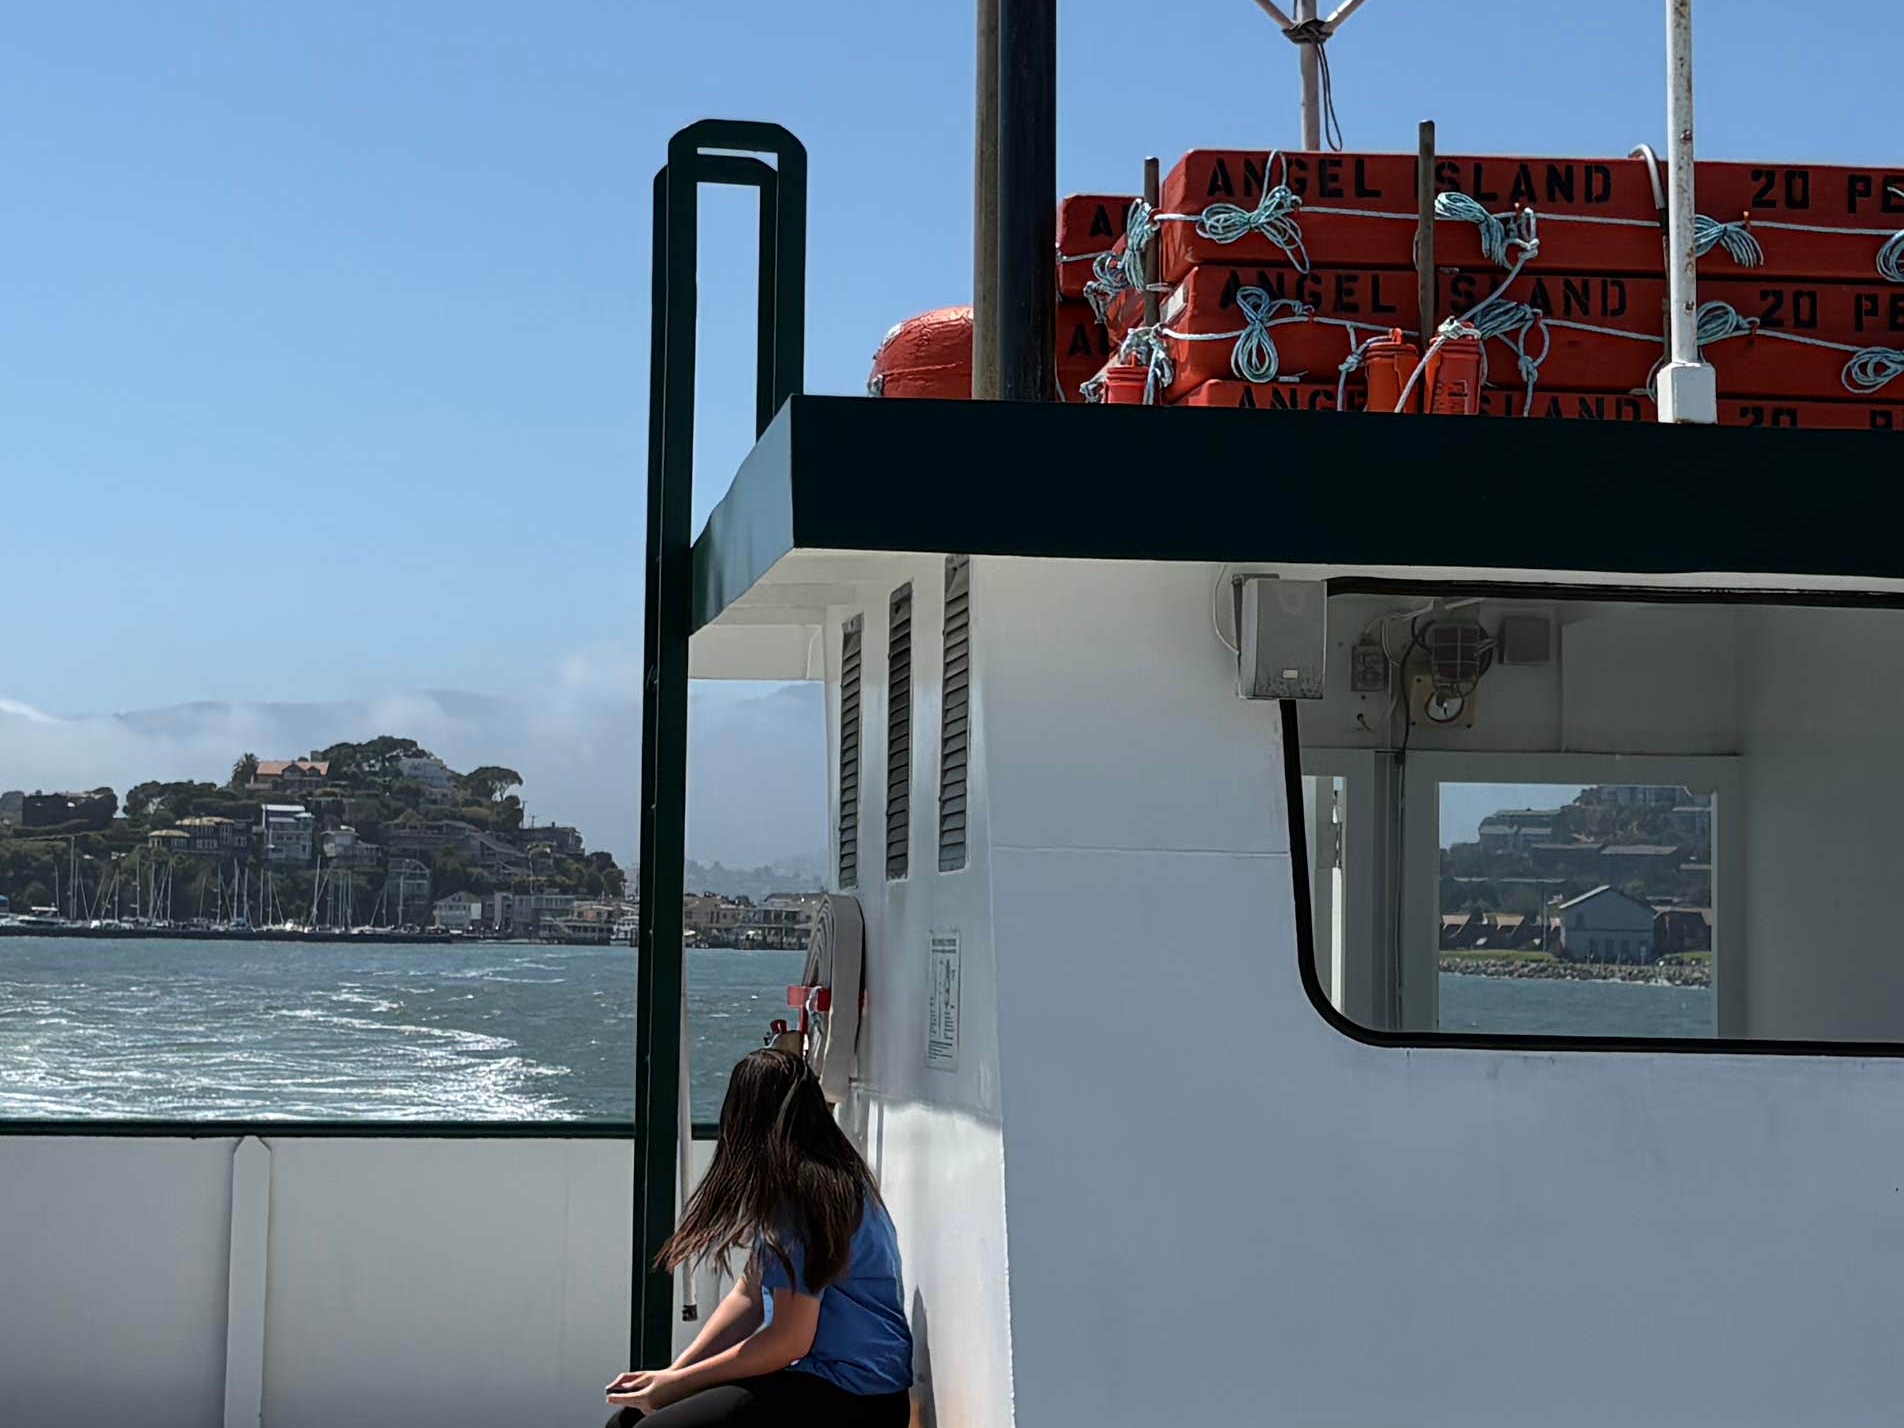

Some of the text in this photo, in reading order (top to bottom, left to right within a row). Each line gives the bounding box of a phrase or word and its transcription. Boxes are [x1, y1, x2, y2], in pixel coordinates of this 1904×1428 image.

[1207, 157, 1382, 198] ANGEL
[1751, 169, 1810, 210] 20
[1435, 274, 1627, 317] ISAND
[1758, 289, 1818, 329] 20
